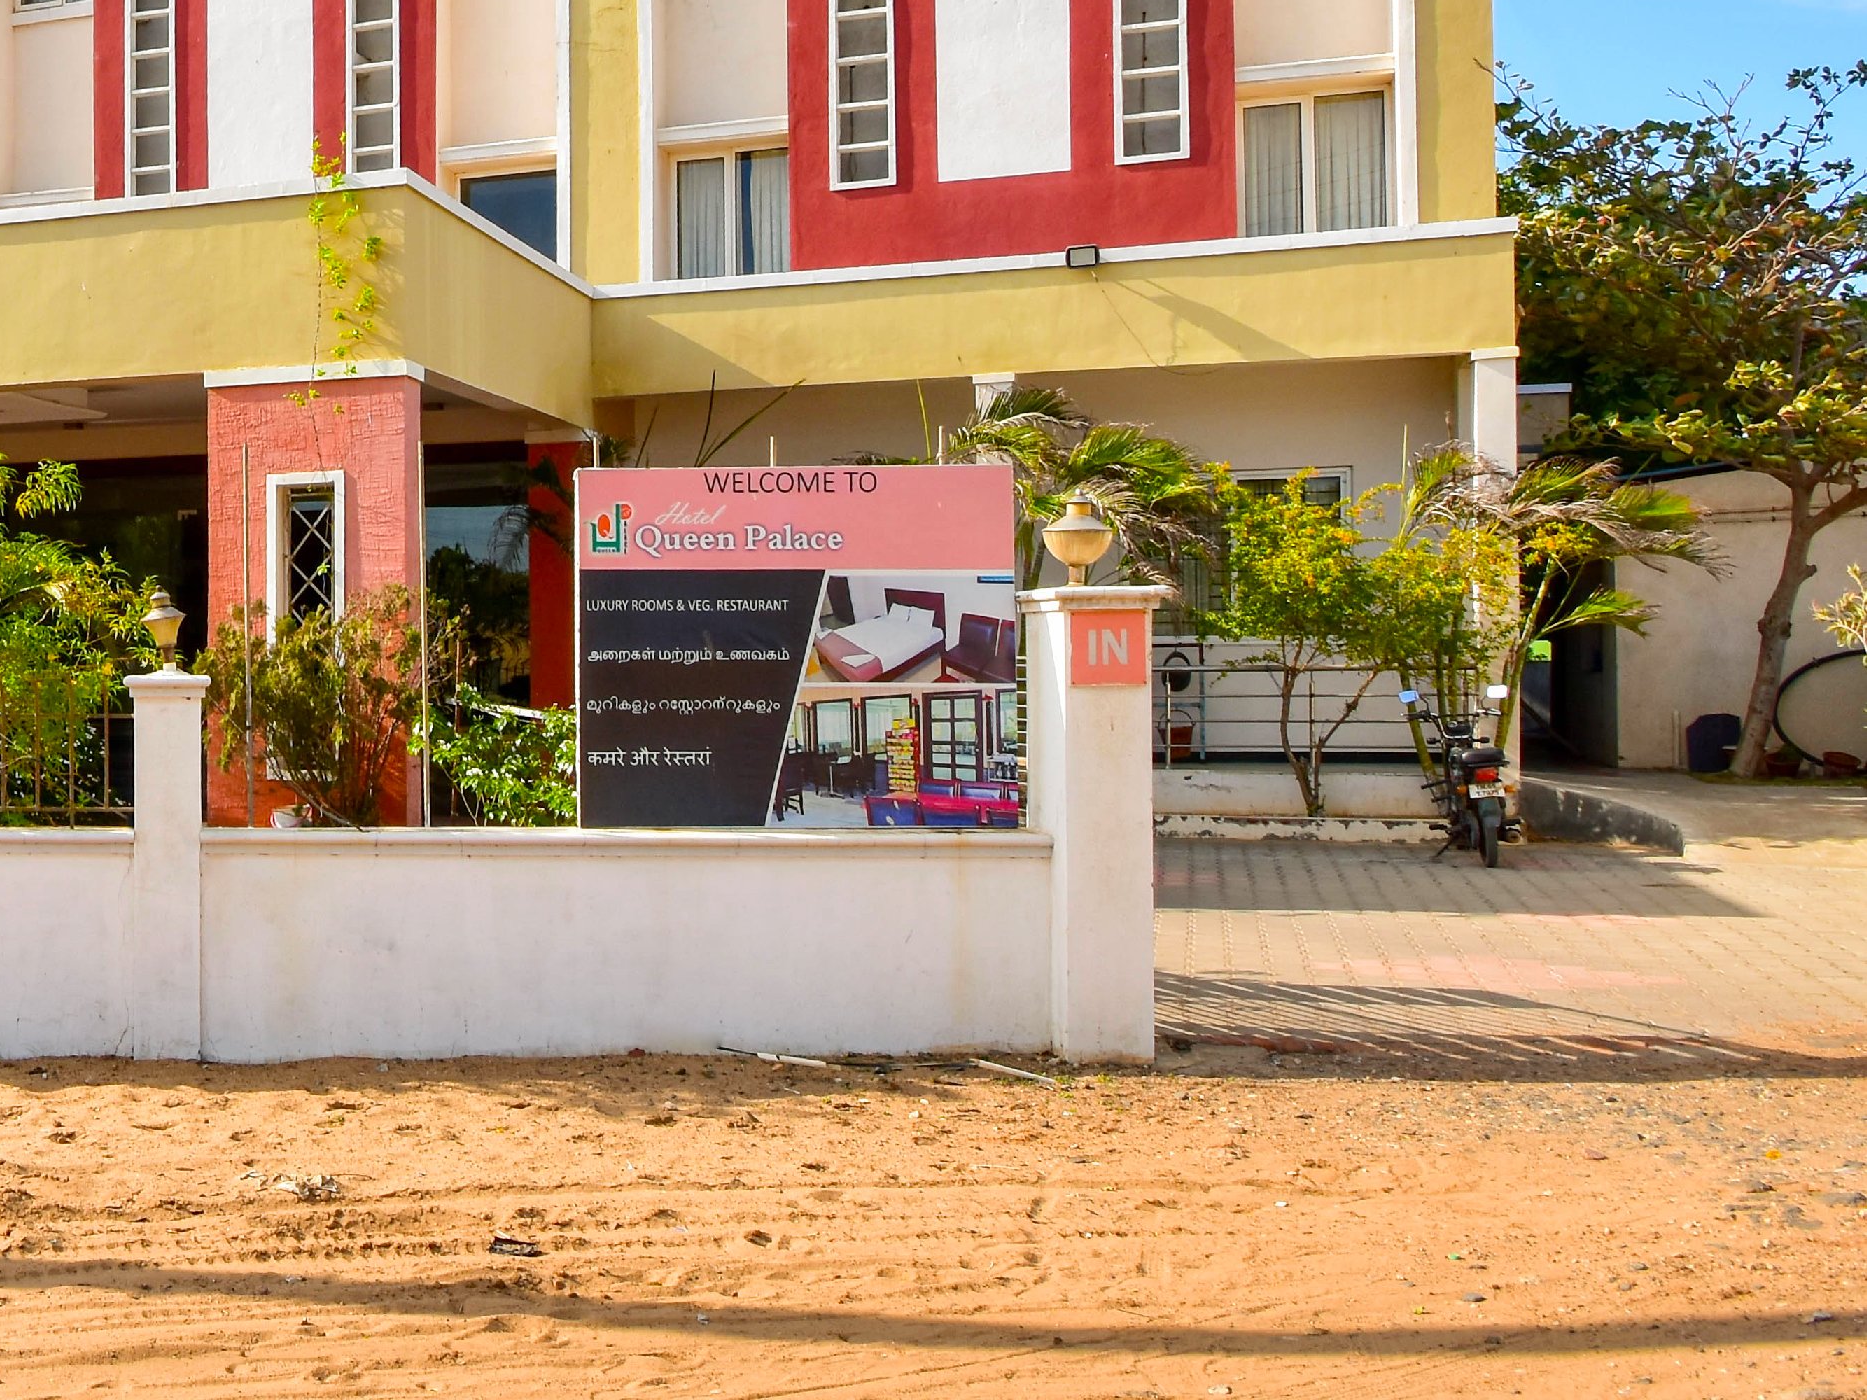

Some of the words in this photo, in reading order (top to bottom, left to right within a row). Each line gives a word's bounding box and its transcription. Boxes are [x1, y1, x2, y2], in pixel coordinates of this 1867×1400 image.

[704, 471, 835, 494] WELCOME
[844, 471, 877, 494] TO
[655, 502, 727, 525] Hotel
[635, 524, 735, 558] Queen
[744, 524, 843, 551] Palace
[586, 600, 628, 611] LUXURY
[631, 600, 673, 611] ROOMS
[677, 600, 685, 611] &
[688, 600, 714, 611] VEG.
[716, 600, 789, 611] RESTAURANT
[587, 647, 655, 663] அறைகள்
[658, 647, 712, 665] மற்றும்
[715, 647, 790, 662] உணவகம்
[1087, 628, 1128, 666] IN
[587, 747, 626, 766] कमरे
[630, 747, 660, 766] और
[664, 747, 712, 766] रेस्तरां
